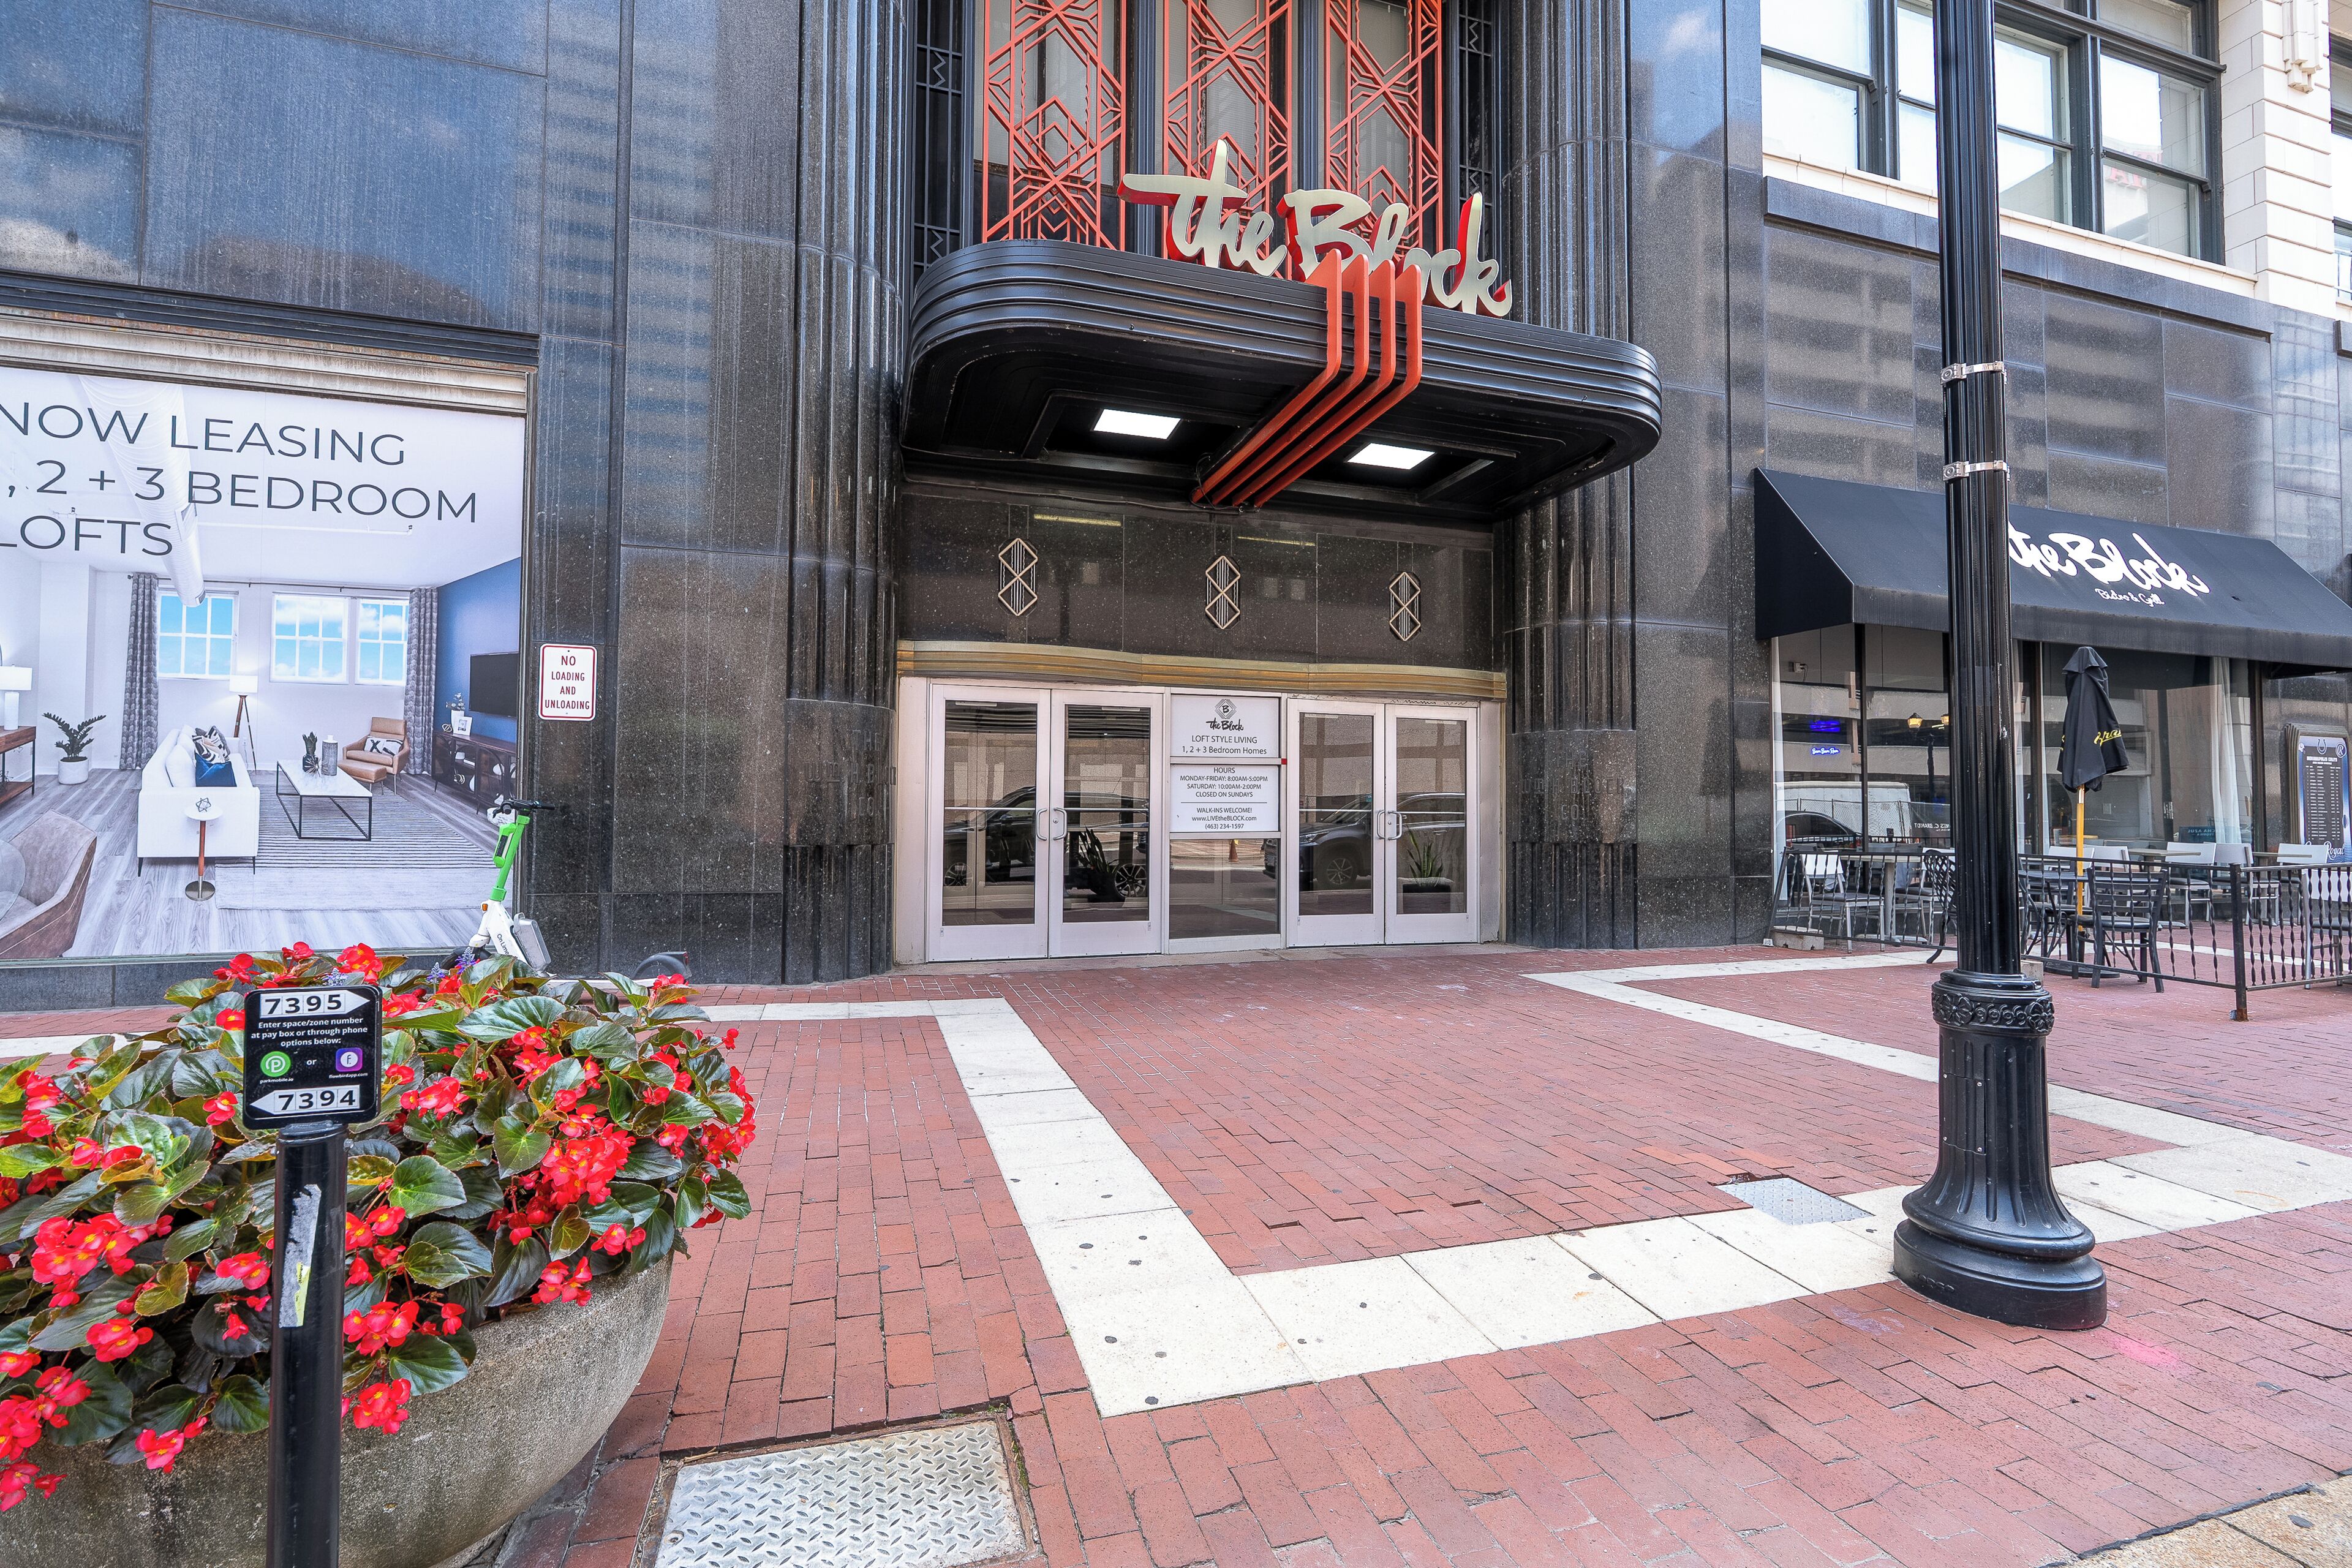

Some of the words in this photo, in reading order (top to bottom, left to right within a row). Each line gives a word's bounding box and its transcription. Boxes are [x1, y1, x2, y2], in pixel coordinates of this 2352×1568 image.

[1117, 138, 1287, 277] the
[1276, 188, 1513, 318] Block
[0, 402, 148, 444] NOW
[171, 415, 405, 466] LEASING
[36, 459, 67, 495] 2
[88, 470, 116, 491] +
[134, 466, 165, 501] 3
[187, 470, 477, 523] BEDROOM
[2048, 532, 2211, 597] Block
[2095, 588, 2130, 601] Bistro
[2138, 592, 2166, 608] Grill
[561, 655, 576, 666] NO
[551, 671, 586, 681] LOADING
[560, 686, 576, 695] AND
[545, 699, 590, 710] UNLOADING
[1205, 717, 1221, 731] the
[1221, 718, 1244, 732] Block
[1182, 745, 1188, 754] 1,
[1208, 745, 1241, 754] Bedroom
[497, 933, 503, 943] On
[500, 941, 510, 956] Lime
[265, 993, 342, 1015] 7395
[258, 1021, 281, 1030] Enter
[282, 1019, 330, 1029] space/zone
[331, 1017, 364, 1025] number
[262, 1031, 277, 1040] pay
[307, 1028, 341, 1038] through
[342, 1027, 368, 1035] phone
[281, 1038, 312, 1047] options
[314, 1037, 342, 1046] below:
[277, 1090, 356, 1112] 7394
